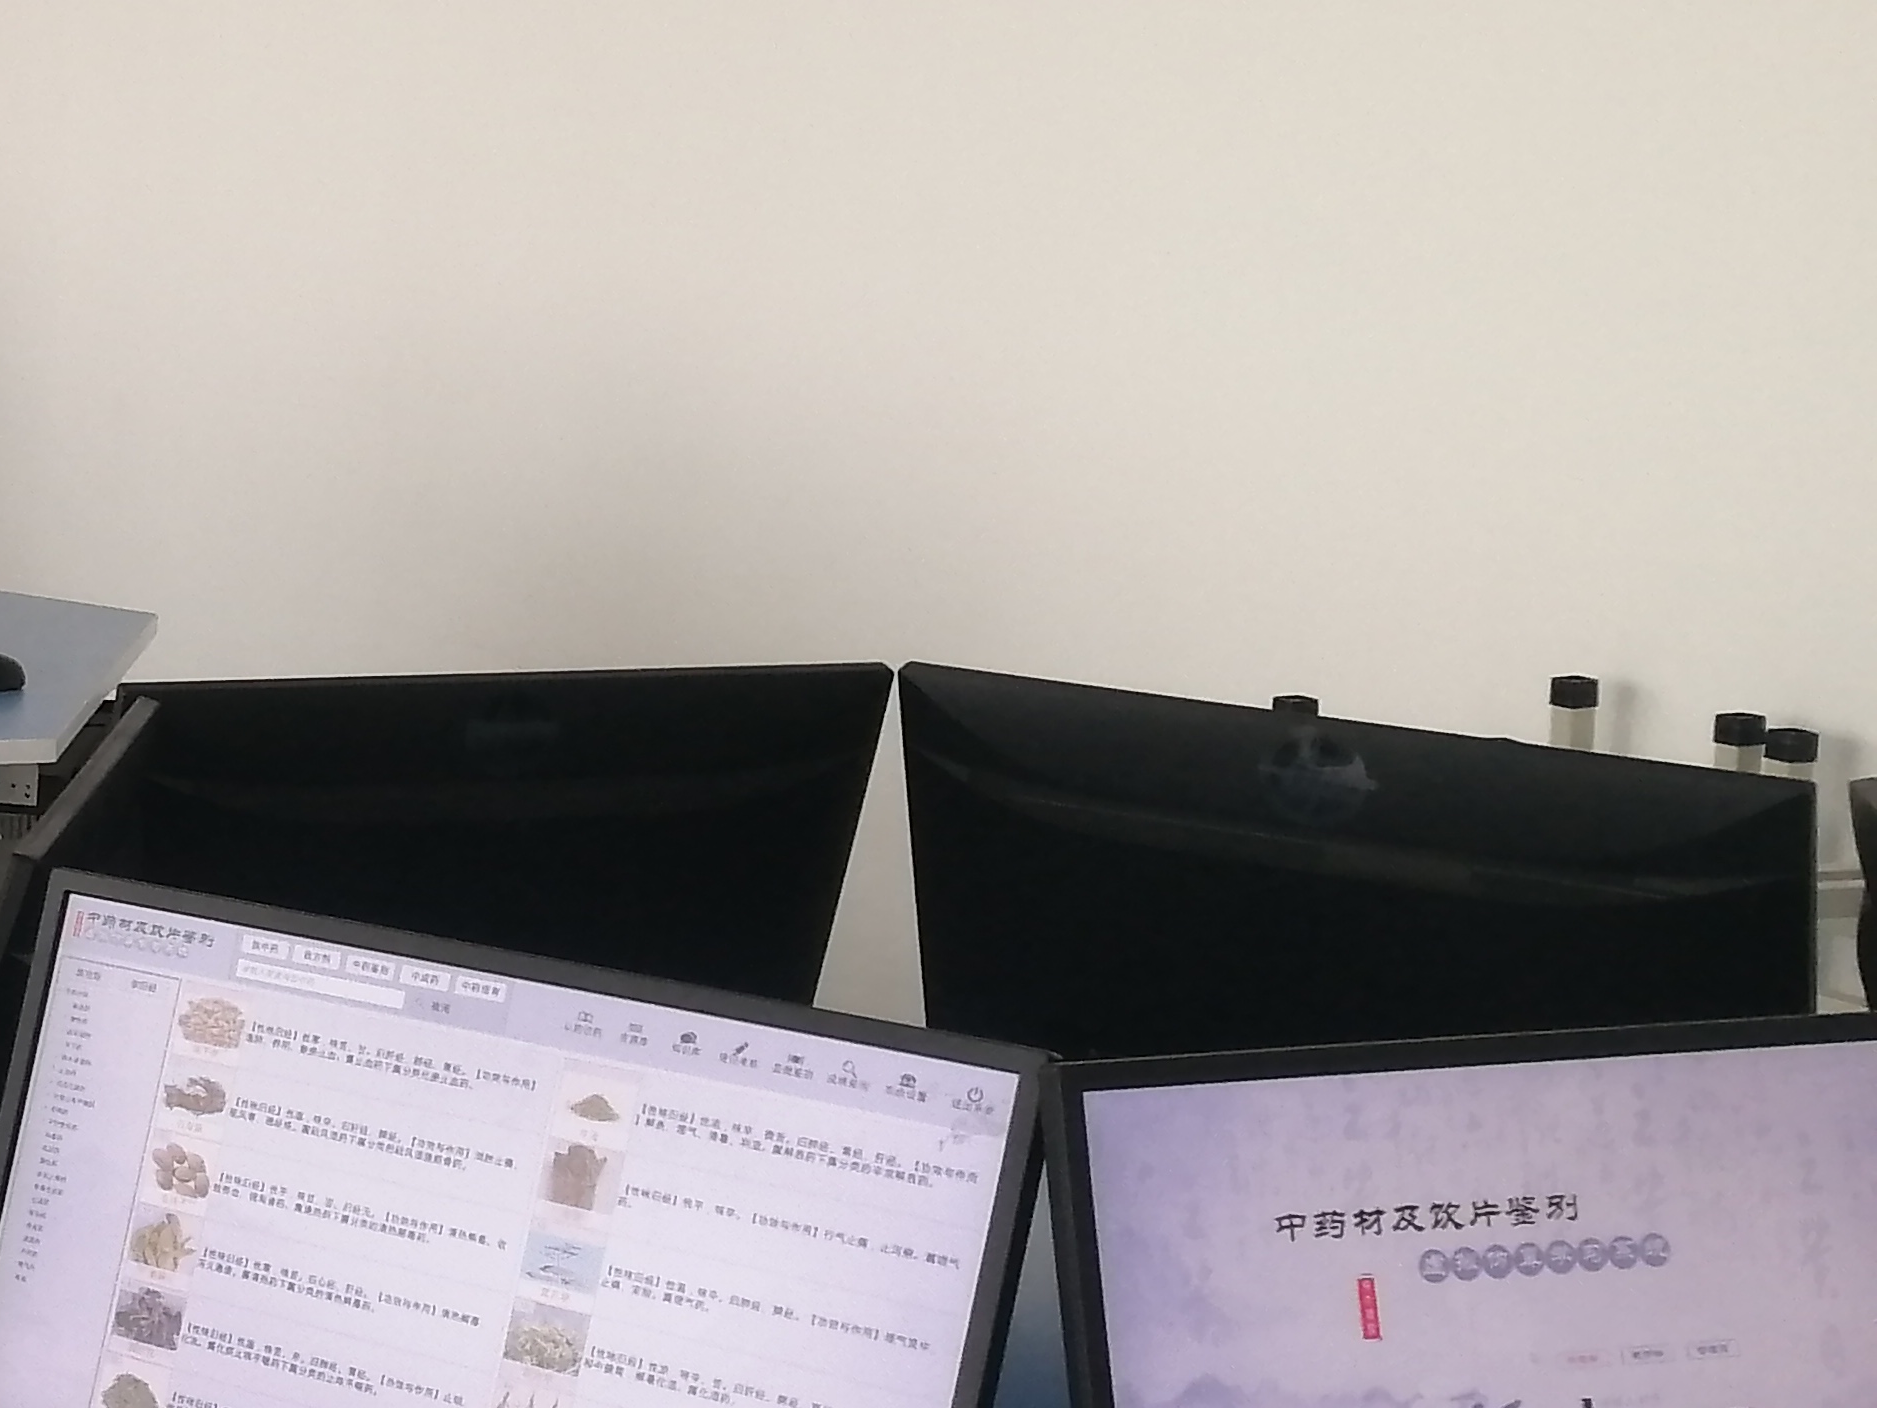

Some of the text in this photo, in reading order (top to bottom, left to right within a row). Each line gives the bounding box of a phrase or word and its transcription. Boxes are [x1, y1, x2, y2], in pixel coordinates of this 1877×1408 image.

[1275, 1193, 1581, 1240] 中药材及饮片鉴别
